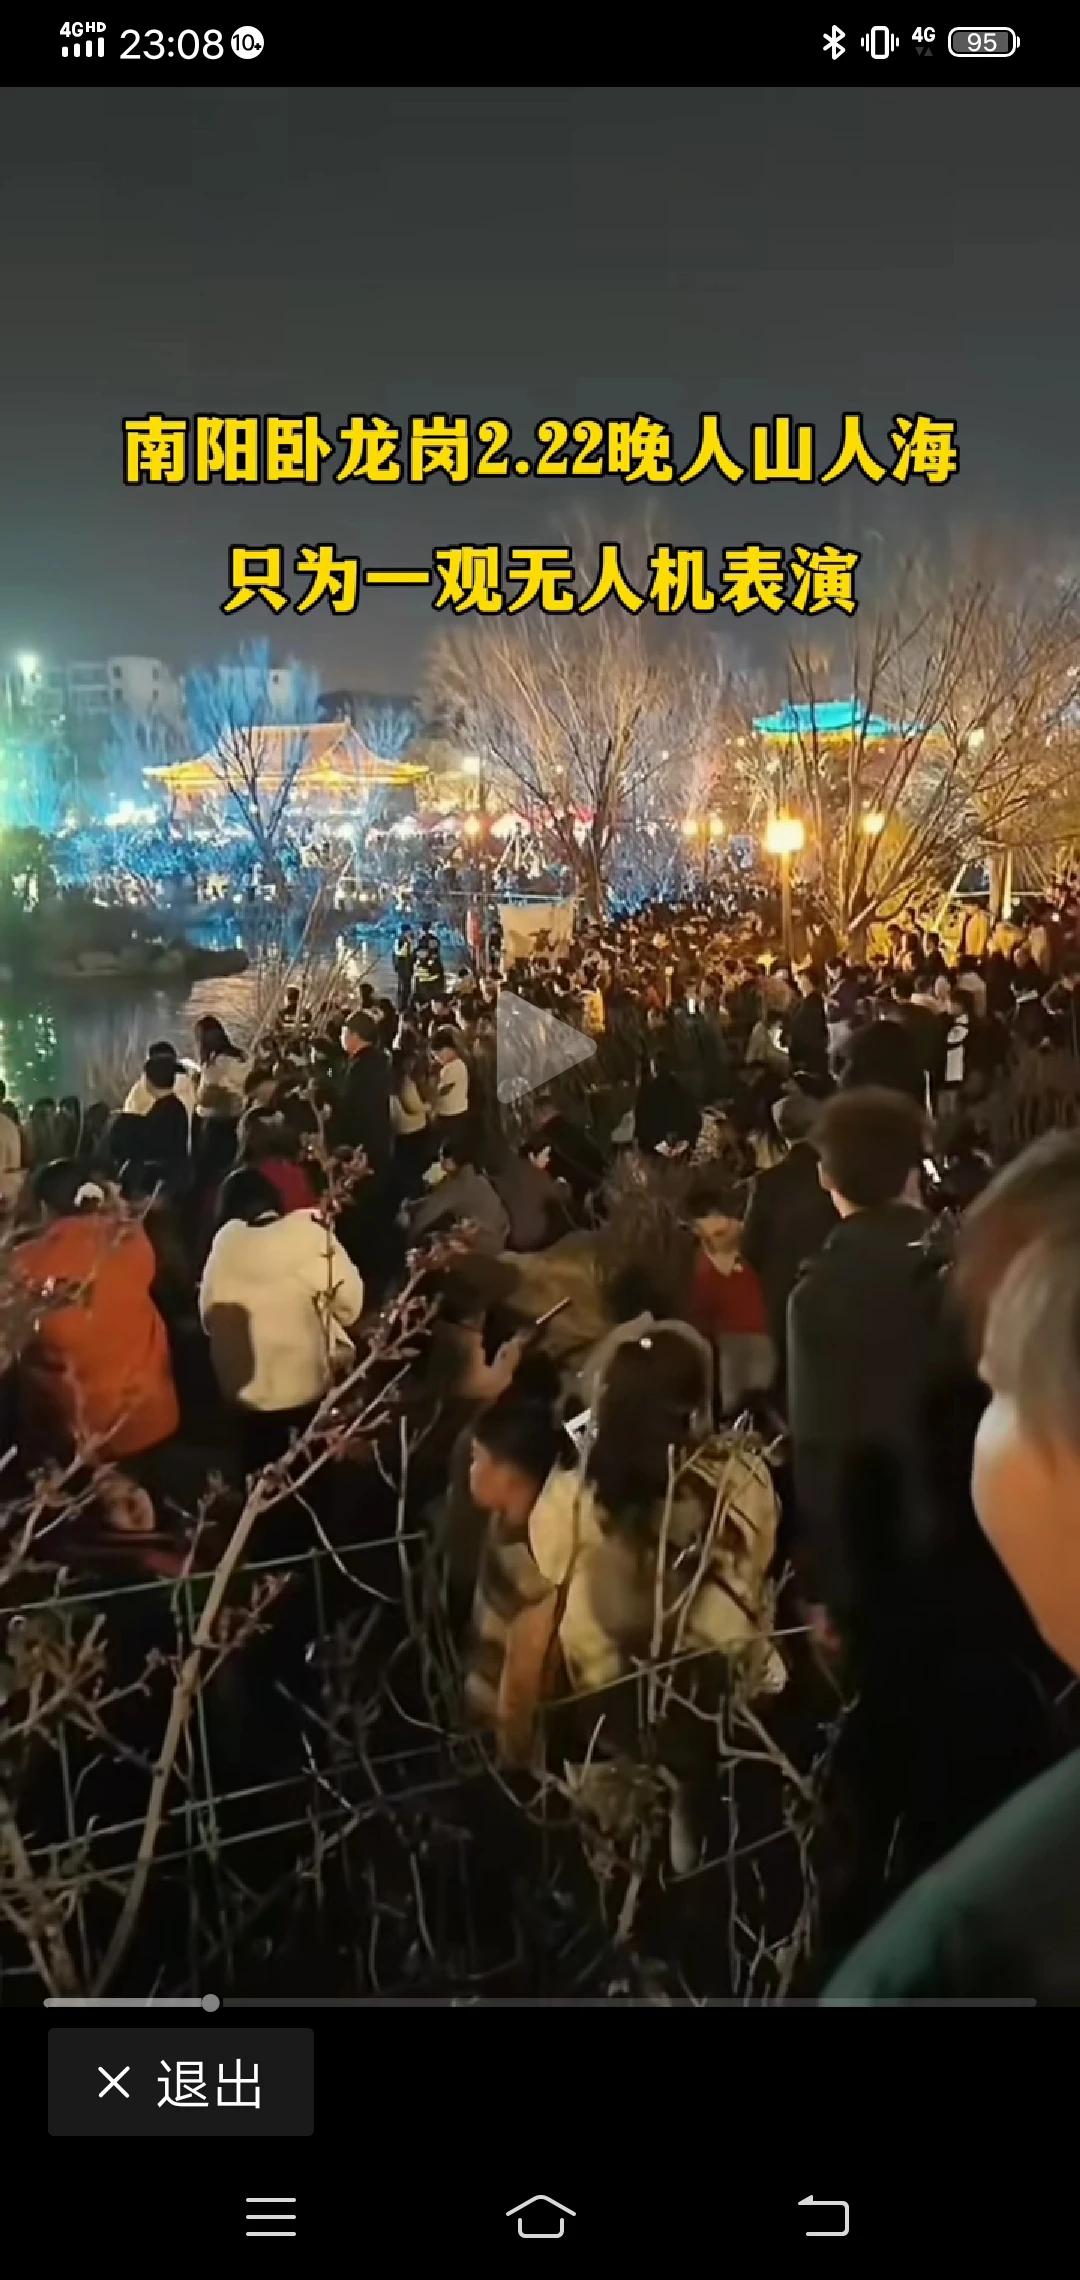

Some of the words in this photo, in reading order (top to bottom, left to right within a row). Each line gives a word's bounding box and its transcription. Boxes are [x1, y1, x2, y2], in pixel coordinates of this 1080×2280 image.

[119, 28, 224, 60] 23:08
[911, 26, 936, 43] 4G
[967, 32, 997, 52] 95
[156, 2058, 261, 2110] 退出
